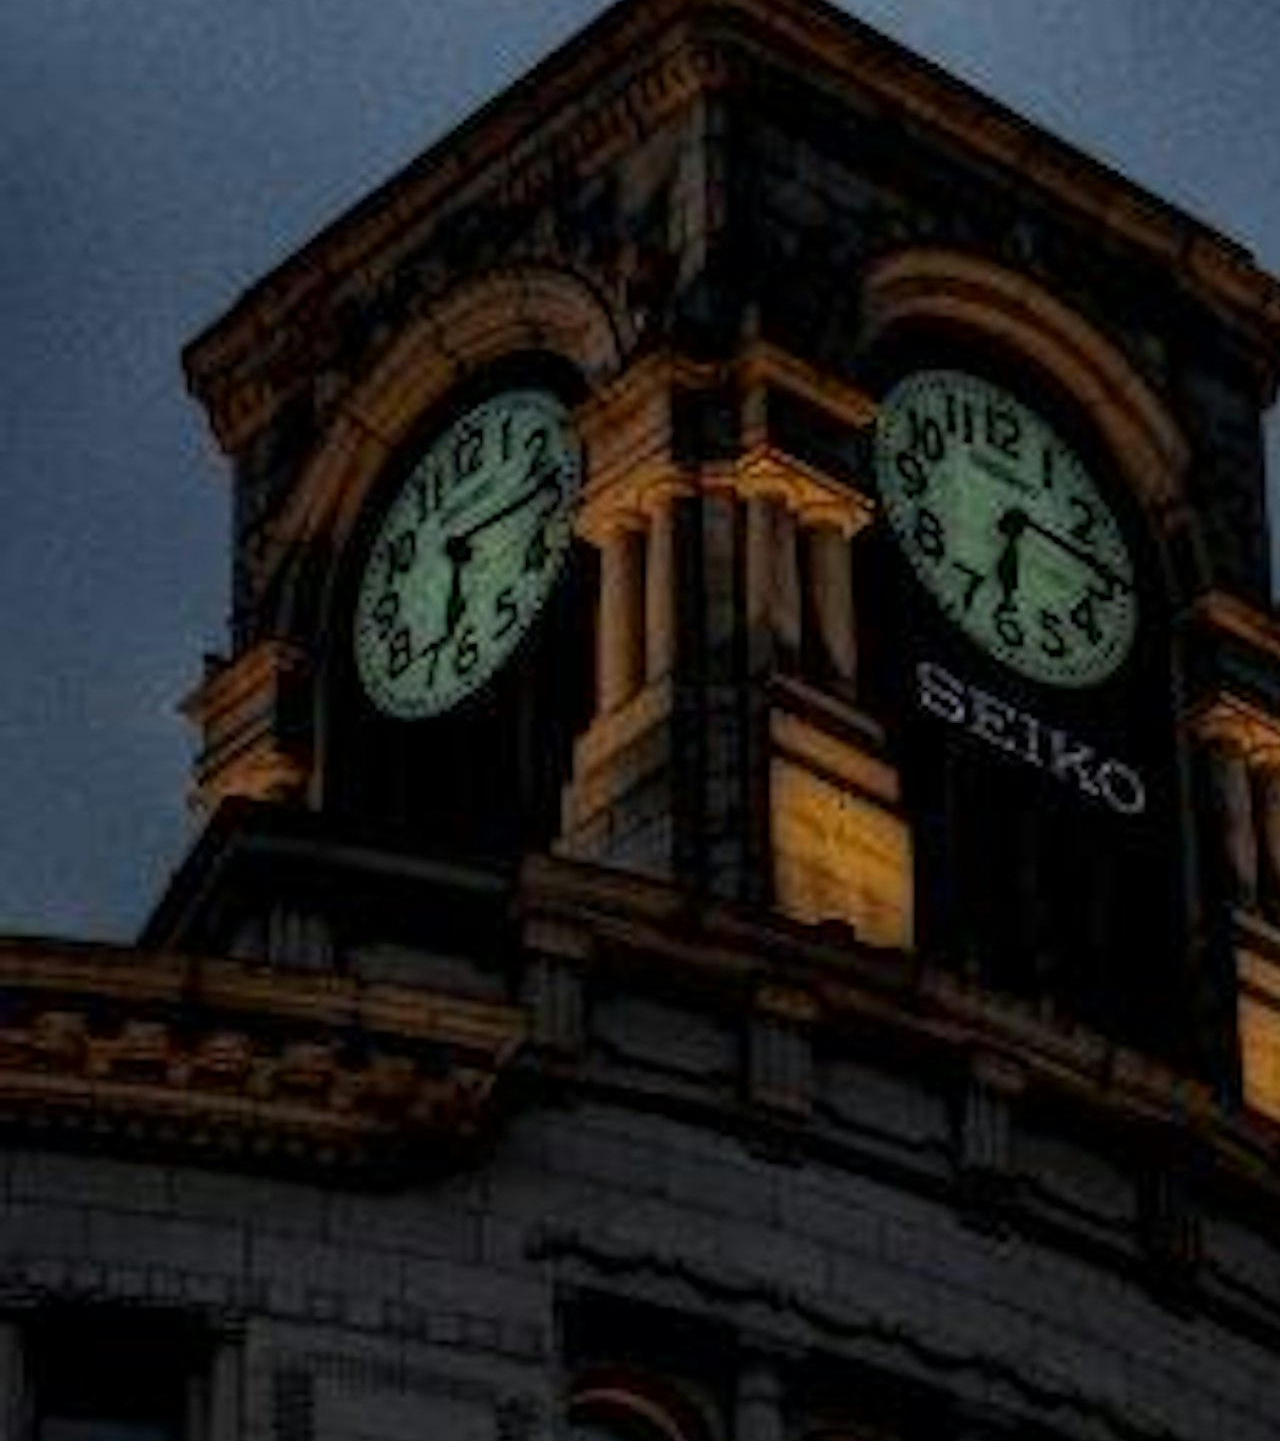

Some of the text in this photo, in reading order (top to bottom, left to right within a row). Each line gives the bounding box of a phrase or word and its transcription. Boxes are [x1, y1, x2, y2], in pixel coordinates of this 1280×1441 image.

[909, 411, 943, 460] 10
[947, 396, 973, 442] 11
[986, 405, 1019, 457] 12
[897, 452, 926, 497] 9
[919, 508, 944, 557] 8
[1071, 497, 1093, 544] 2
[953, 562, 985, 607] 7
[997, 602, 1023, 646] 6
[1042, 610, 1064, 657] 5
[1072, 598, 1103, 644] 4
[914, 660, 1147, 816] SEIKO
